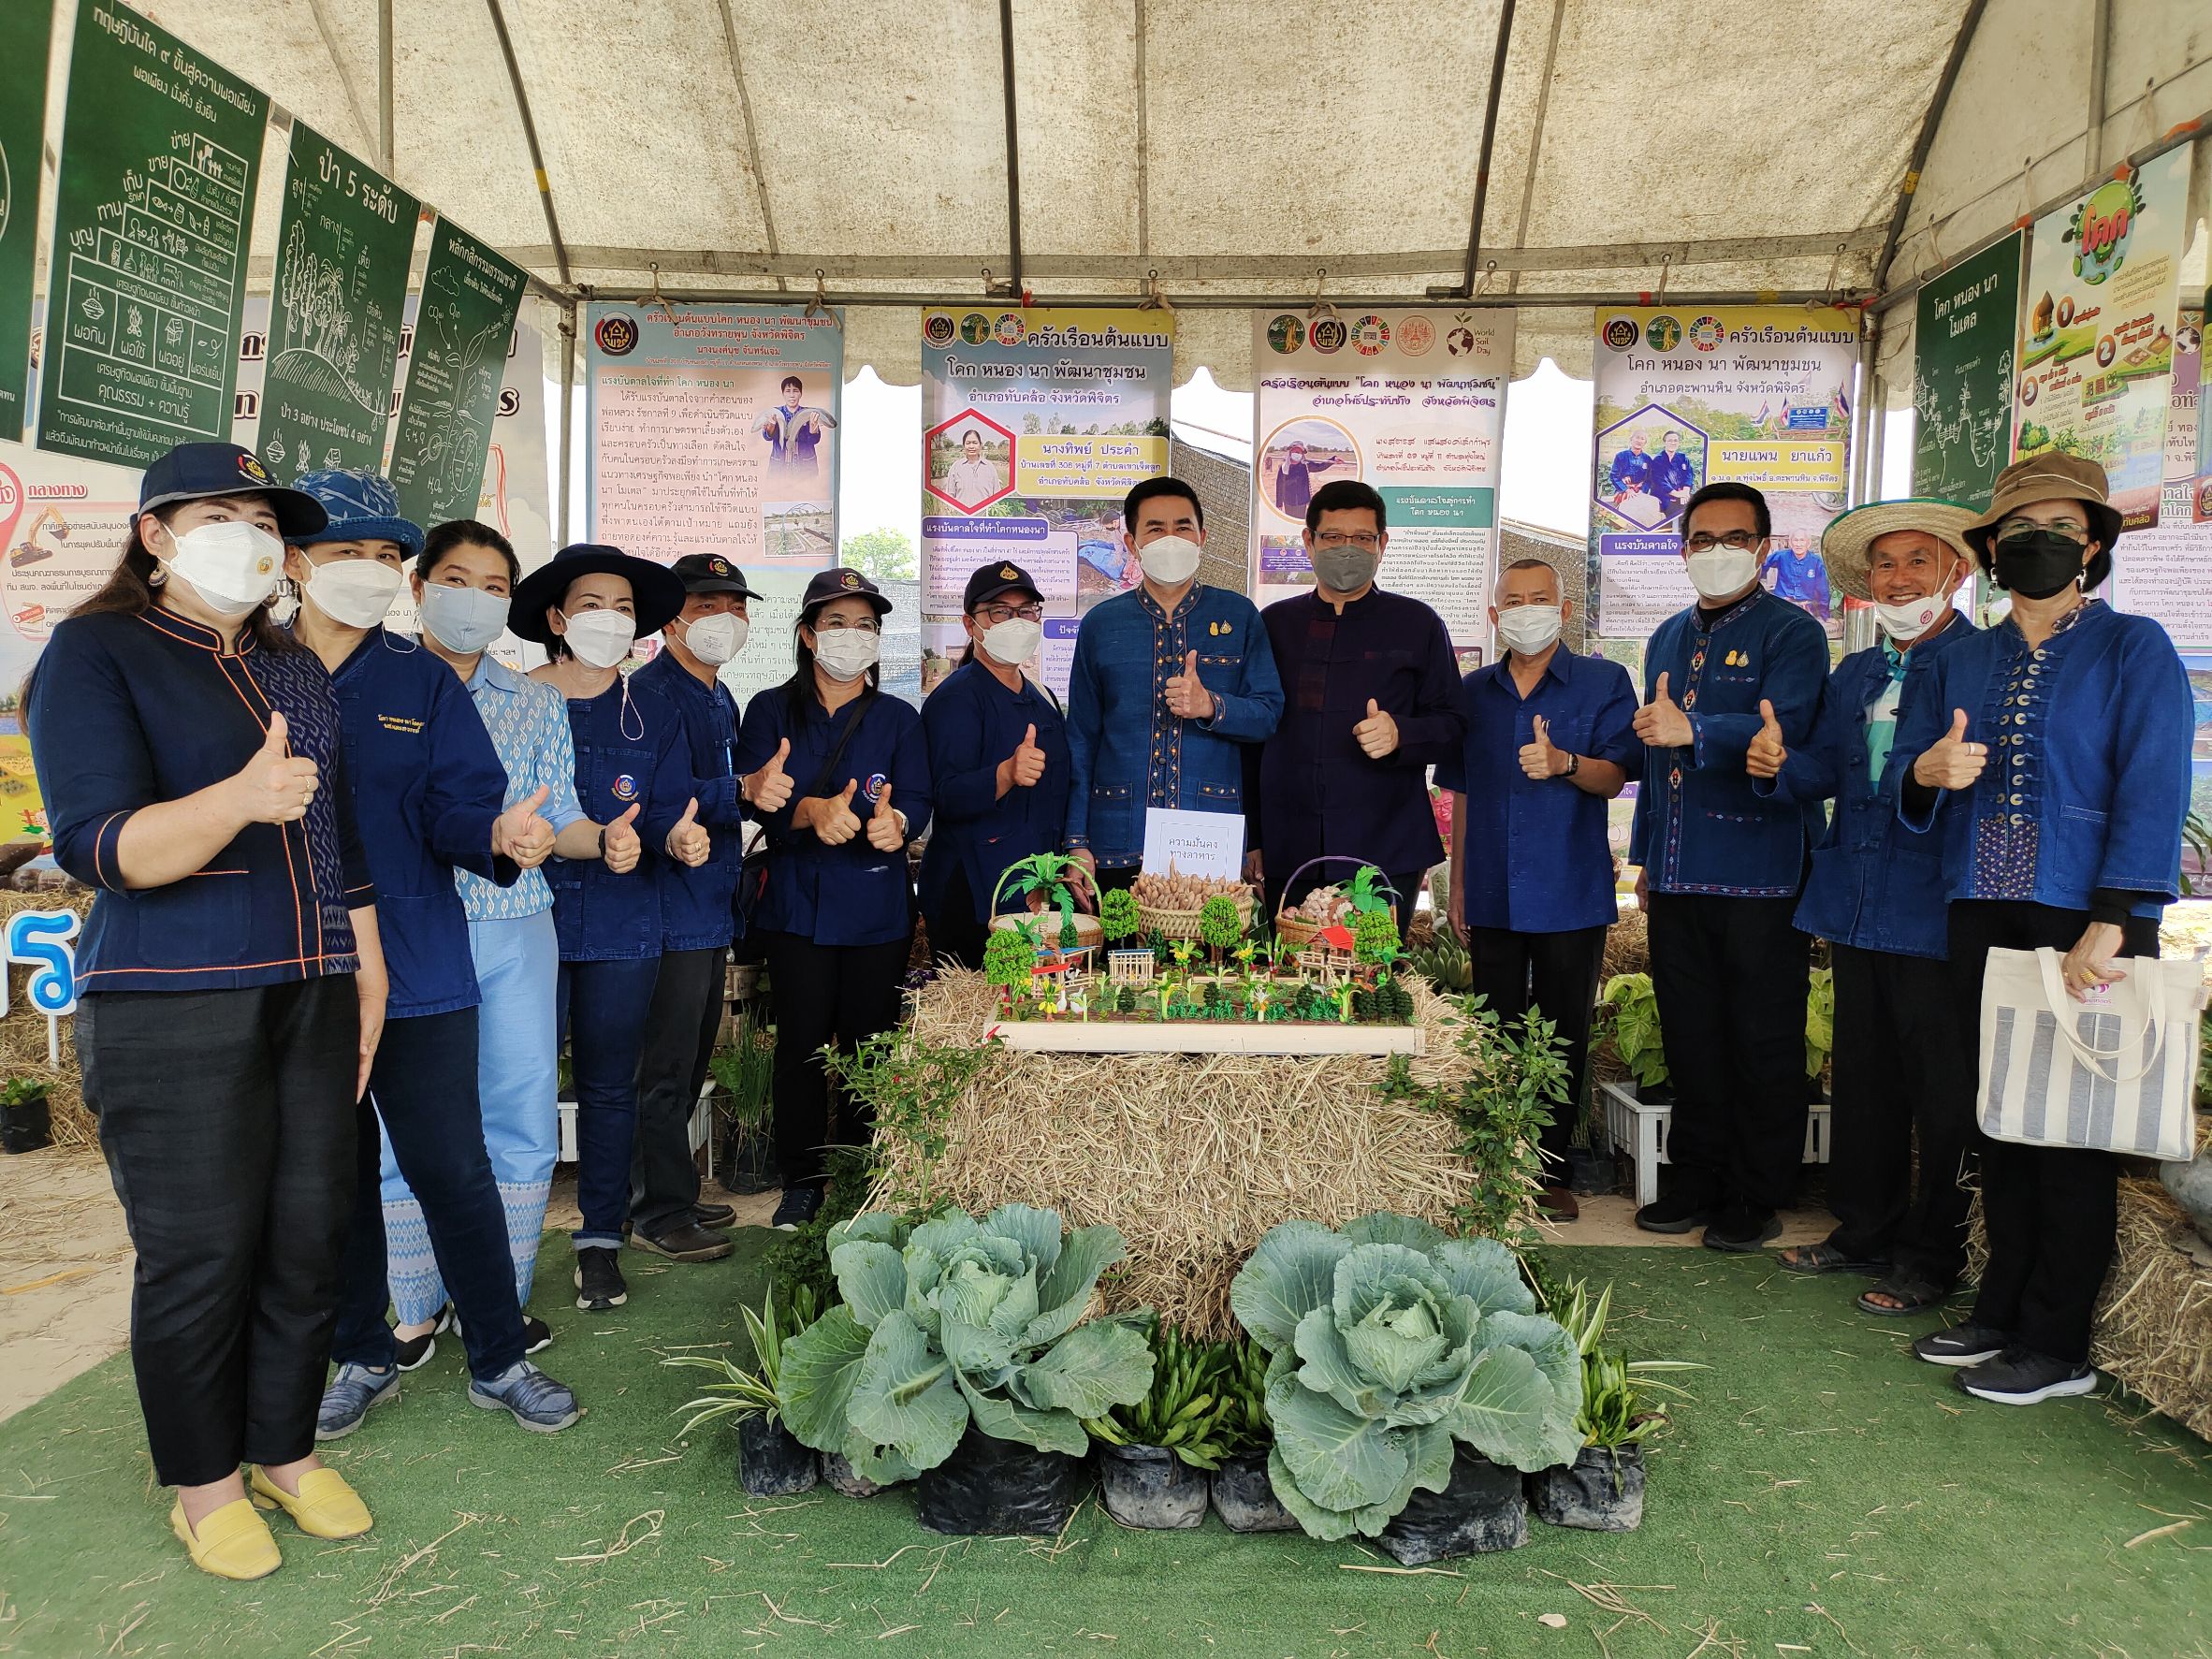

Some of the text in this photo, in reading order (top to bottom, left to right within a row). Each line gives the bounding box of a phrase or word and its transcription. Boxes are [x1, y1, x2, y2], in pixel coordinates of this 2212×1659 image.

[134, 65, 167, 95] พอเพียง
[195, 95, 217, 124] ยั่งยืน
[148, 154, 168, 172] ขาย
[123, 169, 143, 193] เก็บ
[292, 178, 303, 198] สูง
[319, 148, 341, 189] ป่า
[345, 169, 357, 197] 5
[362, 183, 398, 224] ระดับ
[97, 200, 124, 222] ทาน
[319, 214, 339, 235] กลาง
[2081, 204, 2129, 256] โคก
[70, 226, 95, 252] บุญ
[1934, 273, 1998, 320] โคก หนอง นา
[736, 315, 761, 326] หนอง
[764, 316, 776, 325] นา
[1949, 312, 1977, 338] โมเดล
[74, 326, 106, 345] พอกิน
[674, 327, 806, 342] อำเภอวังทรายพูน จังหวัดพิจิตร
[1028, 327, 1169, 347] ครัวเรือนต้นแบบ
[1730, 327, 1854, 344] ครัวเรือนต้นแบบ
[121, 341, 145, 359] พอใช้
[1477, 346, 1490, 357] Day
[159, 350, 185, 373] พออยู่
[948, 357, 1145, 384] โคก หนอง นา พัฒนาชุมชน
[1627, 356, 1822, 376] โคก หนอง นา พัฒนาชุมชน
[602, 375, 674, 386] แรงบันดาลใจที่ทำ
[677, 376, 692, 386] โคก
[696, 378, 720, 387] หนอง
[1260, 378, 1349, 389] ครัวเรือนต้นแบบ
[1385, 380, 1416, 389] หนอง
[1420, 381, 1432, 389] นา
[1640, 381, 1806, 394] อำเภอตะพานหิน จังหวัดพิจิตร
[98, 384, 145, 409] คุณธรรม
[158, 400, 190, 424] ความรู้
[969, 390, 1119, 403] อำเภอทับคล้อ จังหวัดพิจิตร
[1312, 393, 1496, 408] อำเภอโพธิ์ประทับช้าง จังหวัดพิจิตร
[292, 409, 299, 421] 3
[1042, 442, 1139, 455] นางทิพย์ ประคำ
[1723, 448, 1832, 461] นายแพน ยาแก้ว
[28, 484, 88, 500] กลางทาง
[926, 521, 1045, 535] แรงบันดาลใจที่ทำโคกหนองนา
[1614, 538, 1678, 551] แรงบันดาลใจ
[1169, 835, 1218, 849] ความมั่นคง
[1170, 850, 1215, 860] ทางอาหาร
